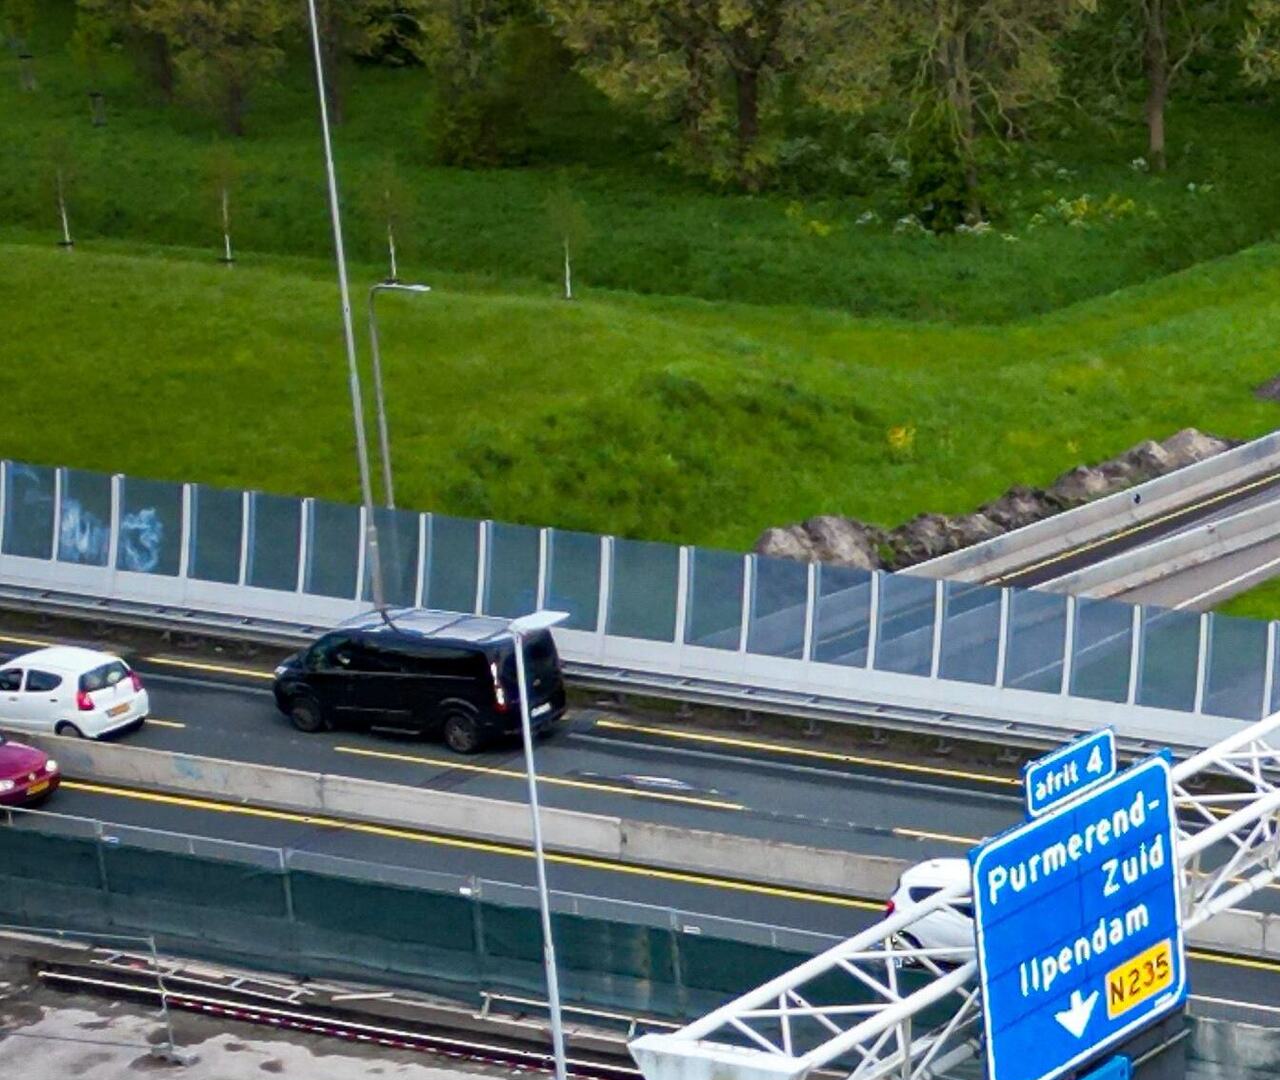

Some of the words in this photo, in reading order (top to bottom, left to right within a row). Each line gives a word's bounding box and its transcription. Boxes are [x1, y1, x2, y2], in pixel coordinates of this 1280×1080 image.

[1035, 761, 1078, 801] afrit
[1085, 743, 1104, 777] 4
[988, 788, 1161, 906] Purmerend-
[1101, 834, 1162, 897] Zuid
[1019, 902, 1149, 998] Ilpendam
[1110, 952, 1169, 1006] N235
